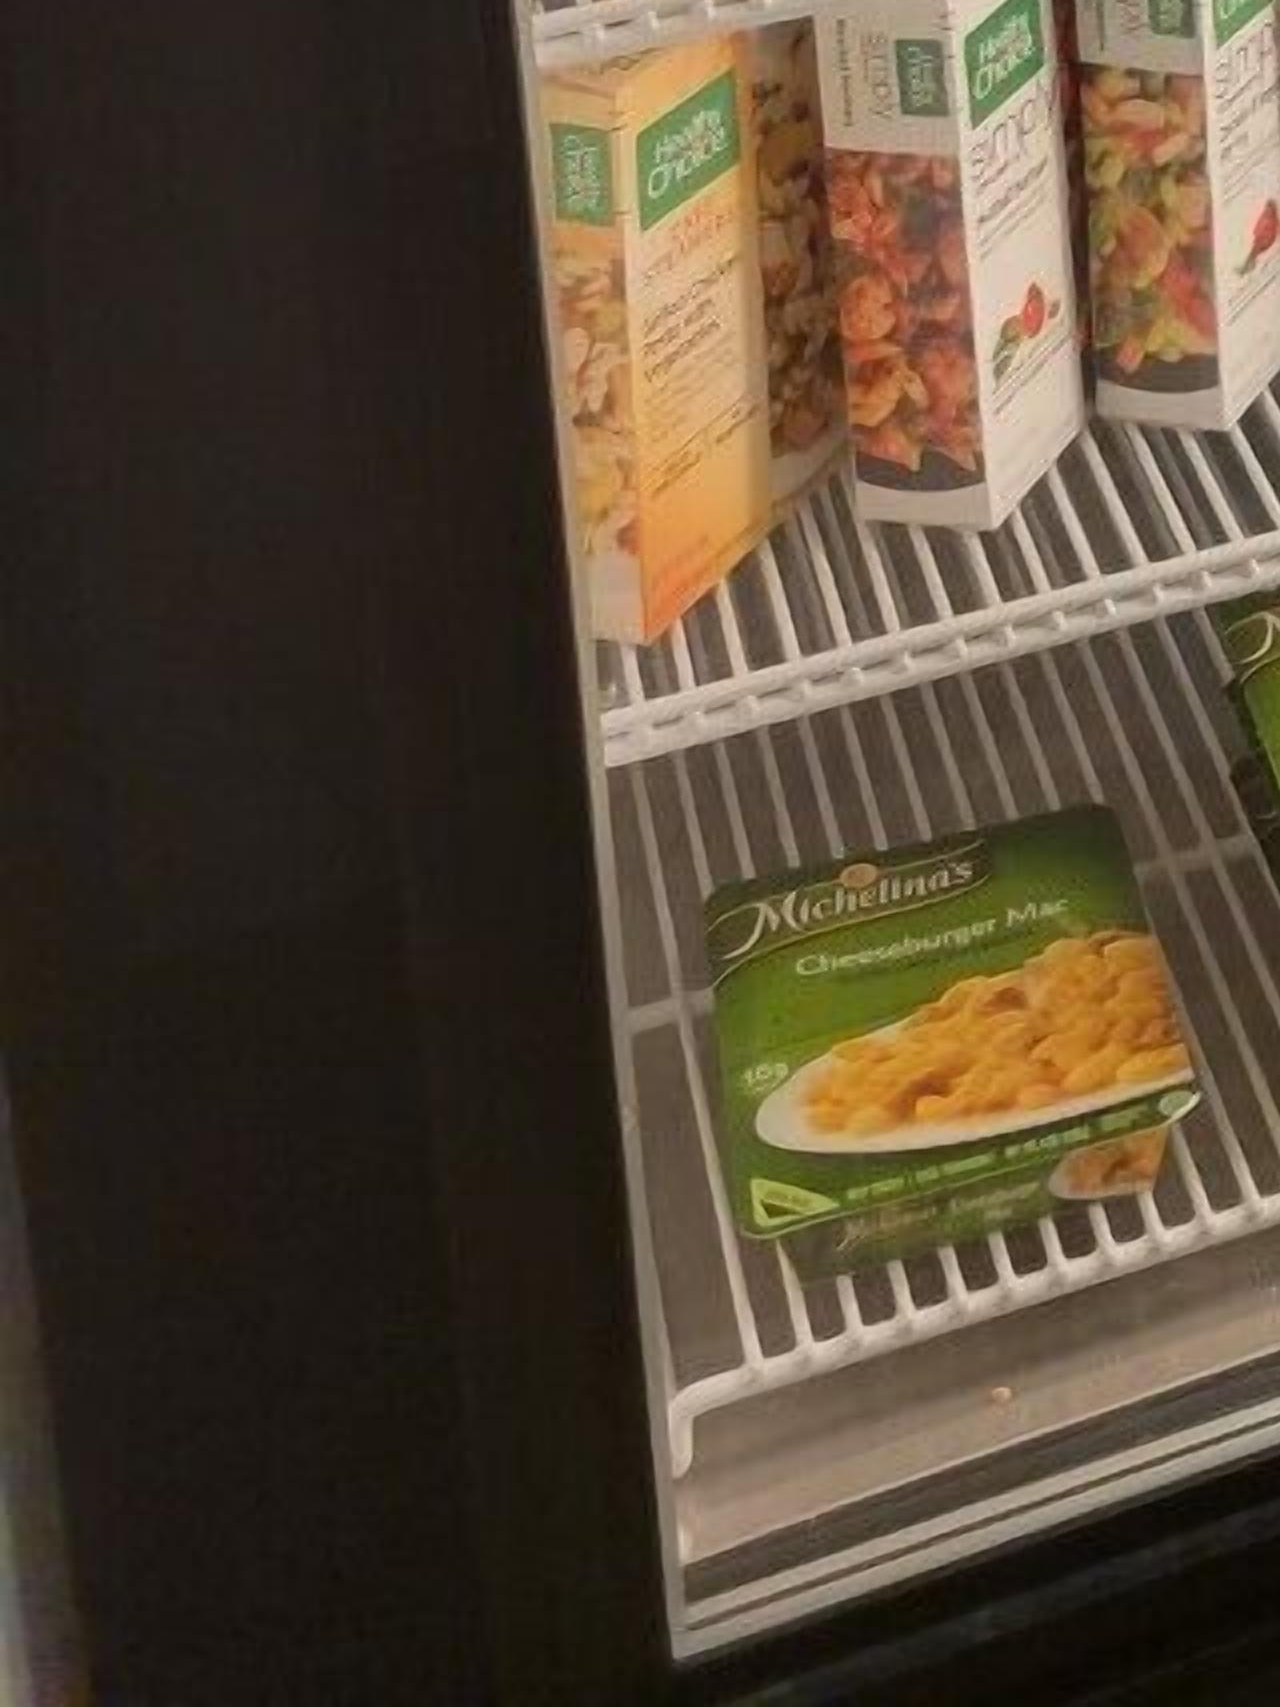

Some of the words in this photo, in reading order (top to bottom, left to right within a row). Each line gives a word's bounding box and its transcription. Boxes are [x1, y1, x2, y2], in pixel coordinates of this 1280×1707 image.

[723, 860, 974, 961] Michelina's
[796, 916, 997, 977] Cheeseburger
[1005, 898, 1070, 929] Mac
